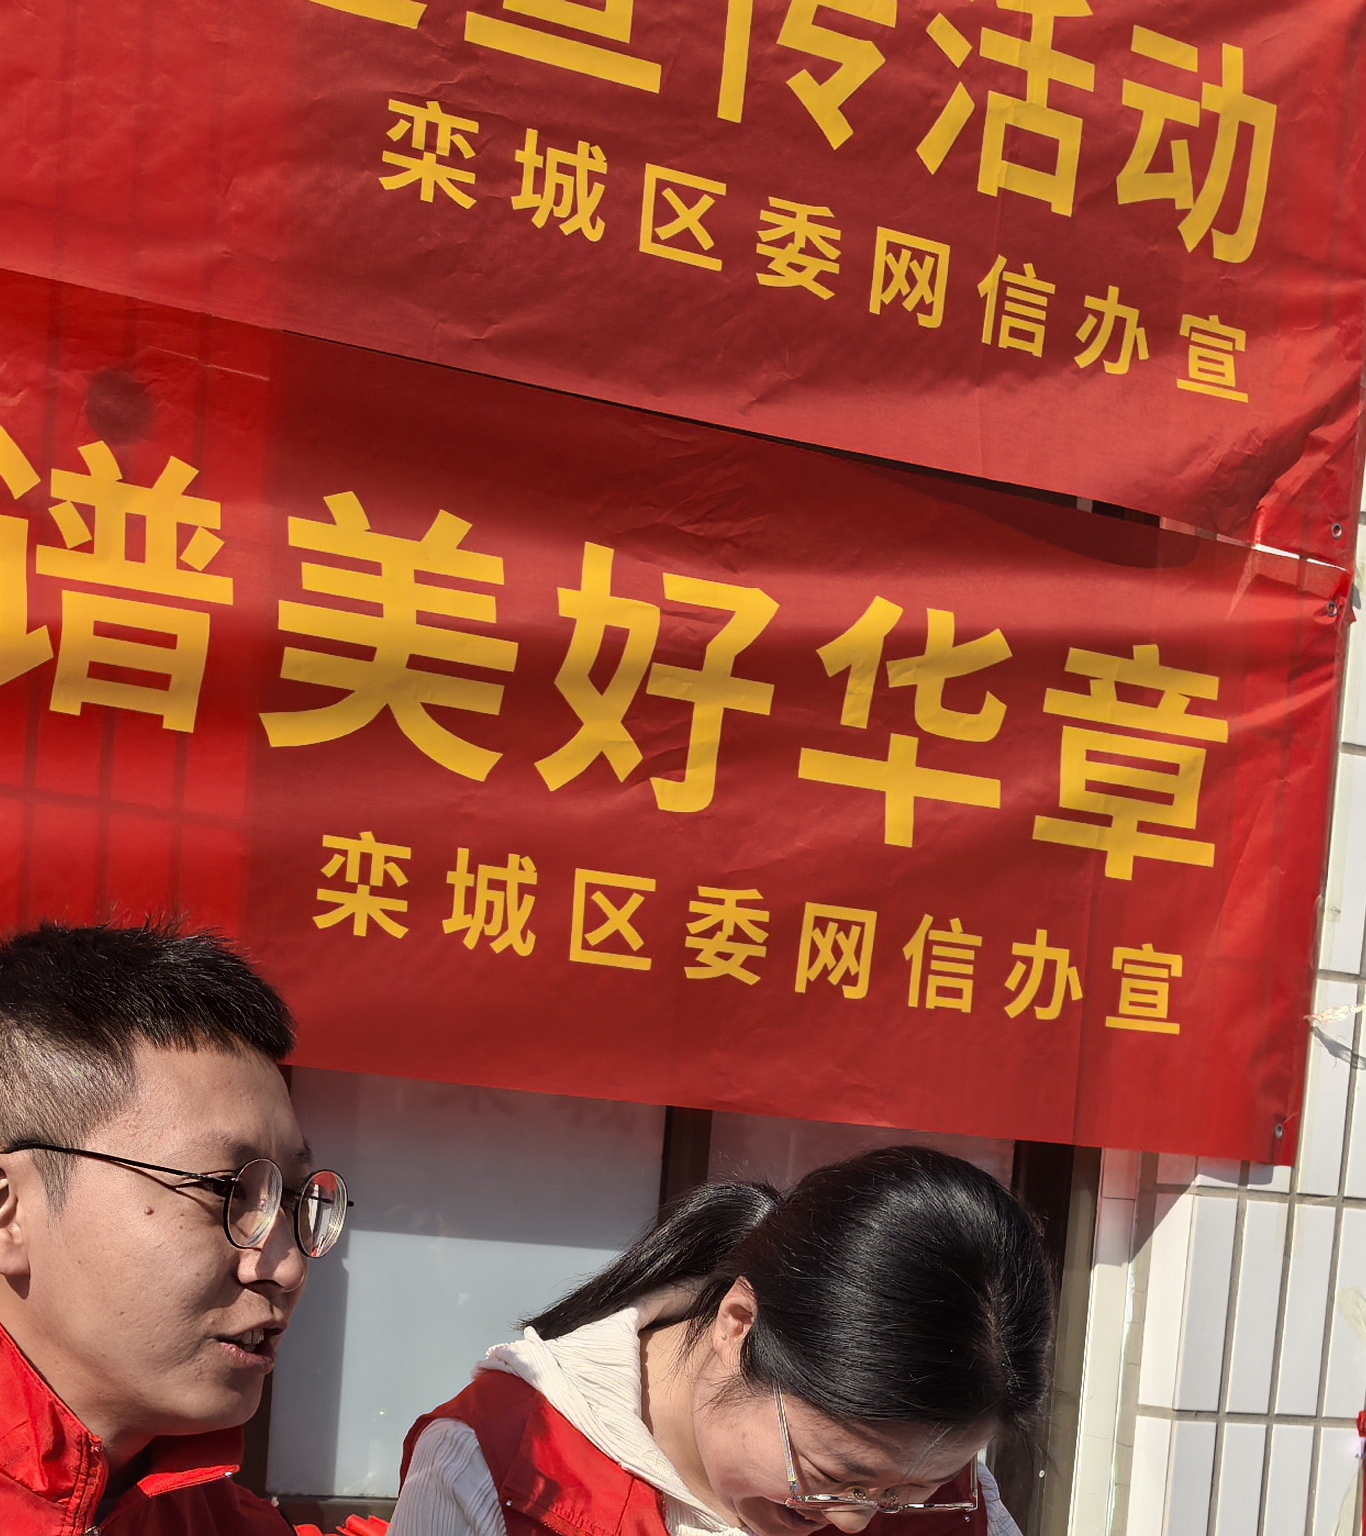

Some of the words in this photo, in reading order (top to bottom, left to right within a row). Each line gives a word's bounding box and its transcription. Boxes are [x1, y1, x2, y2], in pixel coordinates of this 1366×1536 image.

[307, 0, 1278, 264] 传活动
[380, 99, 1250, 404] 栾城区委网信办宣
[312, 832, 1182, 1035] 栾城区委网信办宣
